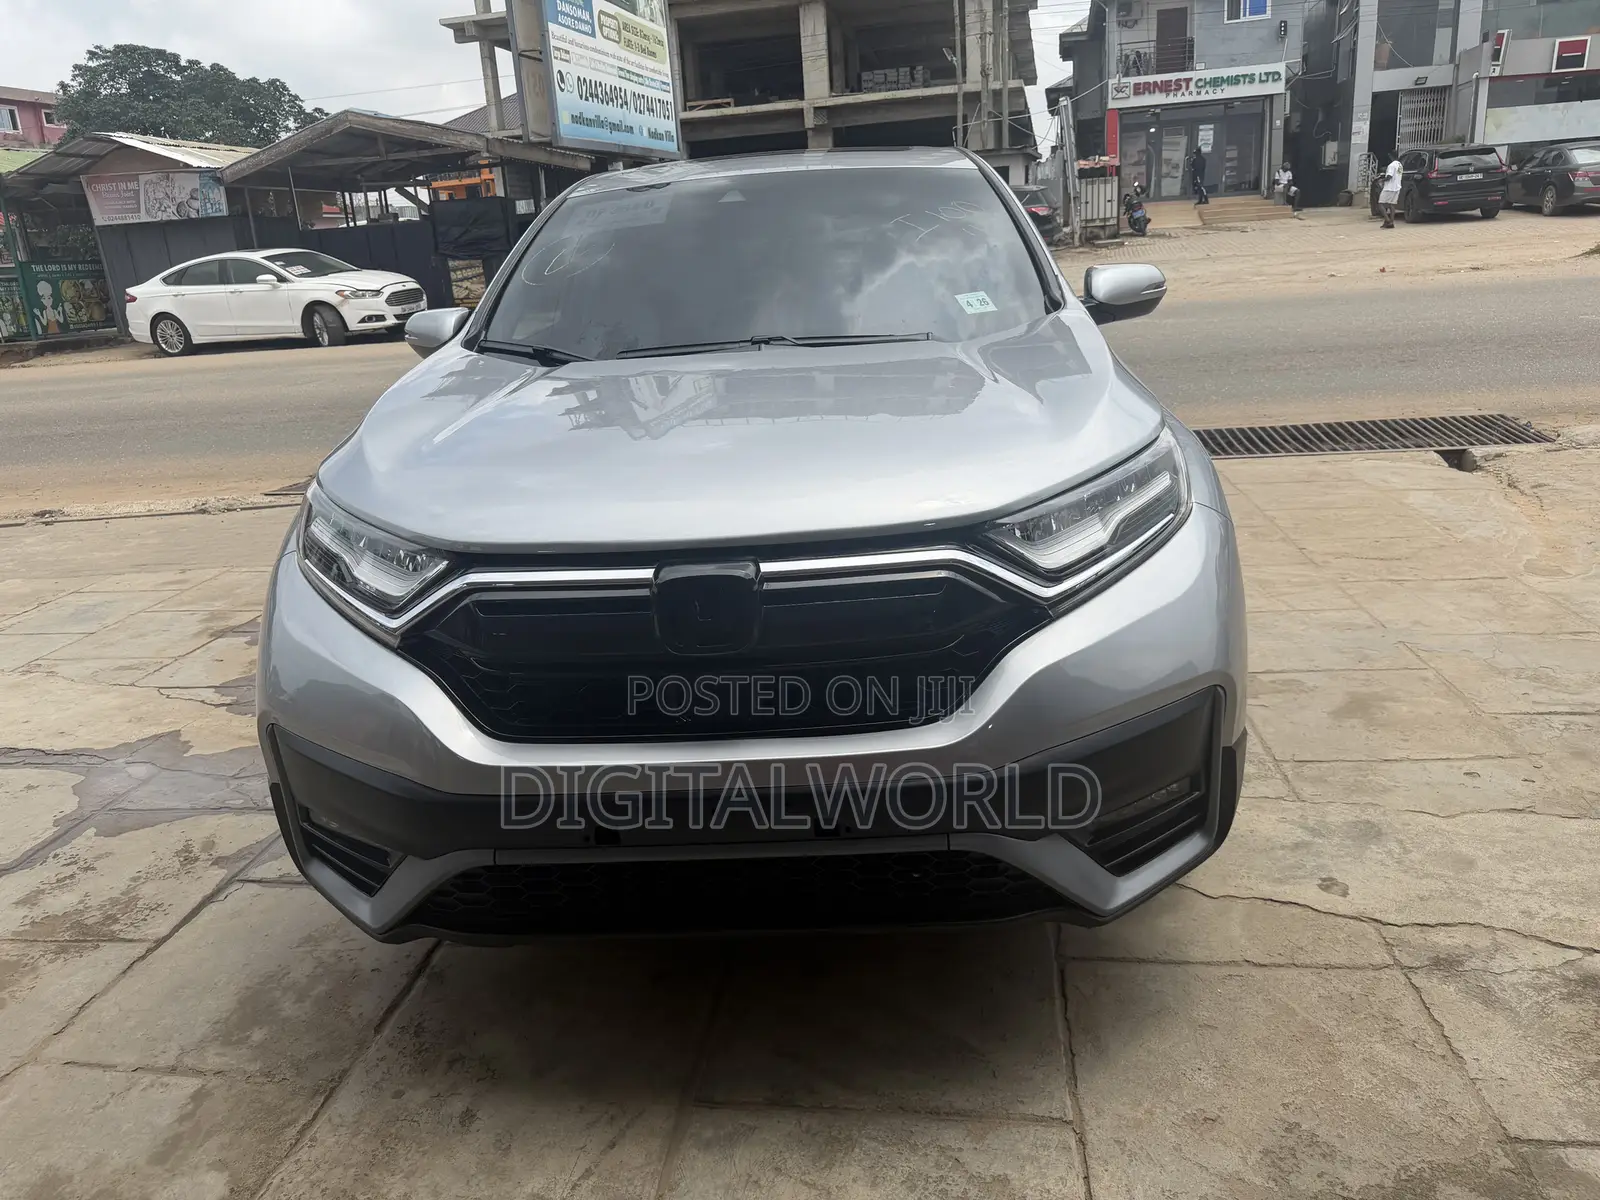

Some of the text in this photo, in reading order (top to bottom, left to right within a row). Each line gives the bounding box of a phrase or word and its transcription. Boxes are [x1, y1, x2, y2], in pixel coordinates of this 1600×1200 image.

[1132, 70, 1282, 96] ERNEST CHEMISTS LTD.
[1165, 88, 1226, 99] PHARMACY
[91, 181, 139, 192] CHRIST IN ME
[31, 264, 44, 272] THE
[44, 264, 61, 272] LORD
[965, 297, 989, 308] 4 26
